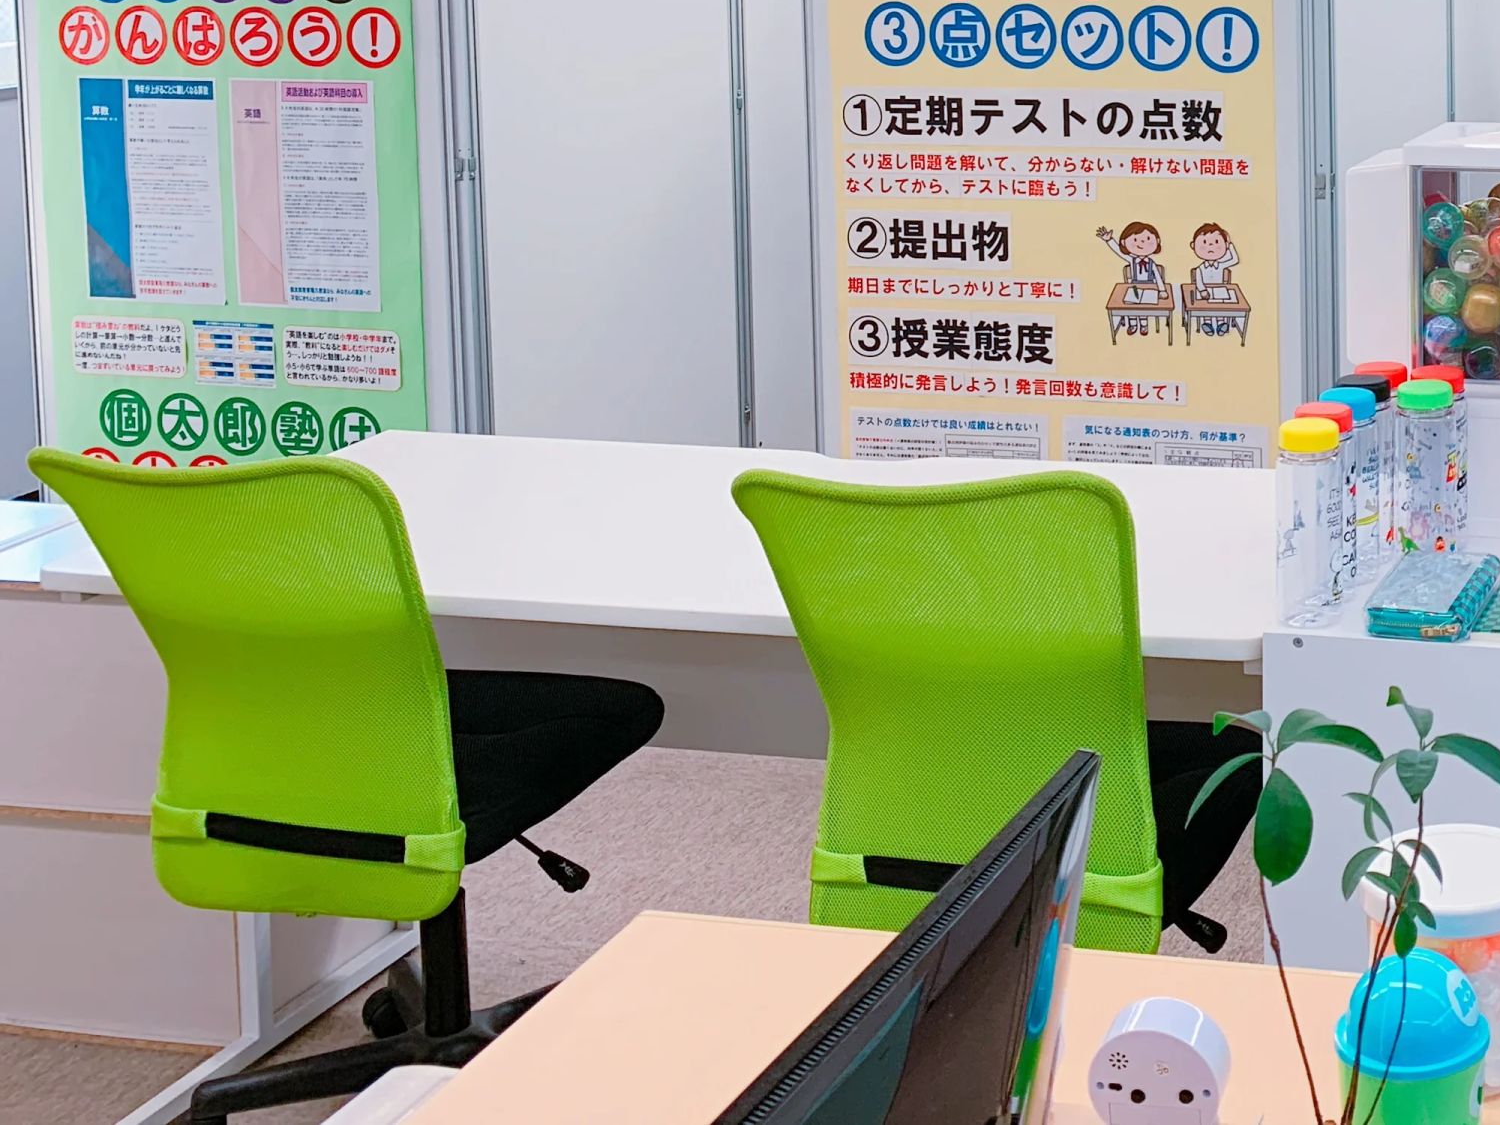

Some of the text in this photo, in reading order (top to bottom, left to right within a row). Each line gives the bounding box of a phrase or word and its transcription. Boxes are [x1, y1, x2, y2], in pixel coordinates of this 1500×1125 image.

[59, 5, 401, 69] がんばろう！
[92, 106, 109, 116] 算数
[244, 108, 261, 119] 英語
[842, 93, 1223, 143] ①定期テストの点数
[845, 153, 1249, 176] くり返し問題を解いて、分からない・解けない問題を
[846, 177, 1091, 199] なくしてから、テストに臨もう！
[847, 216, 1009, 262] ②提出物
[847, 277, 1076, 299] 期日までにしっかりと丁寧に！
[848, 314, 1054, 365] ③授業態度
[849, 374, 1181, 402] 積極的に発言しよう！発言回数も意識して！
[100, 388, 381, 457] 個太郎塾は
[857, 416, 1039, 433] テストの点数だけでは良い成績はとれない！
